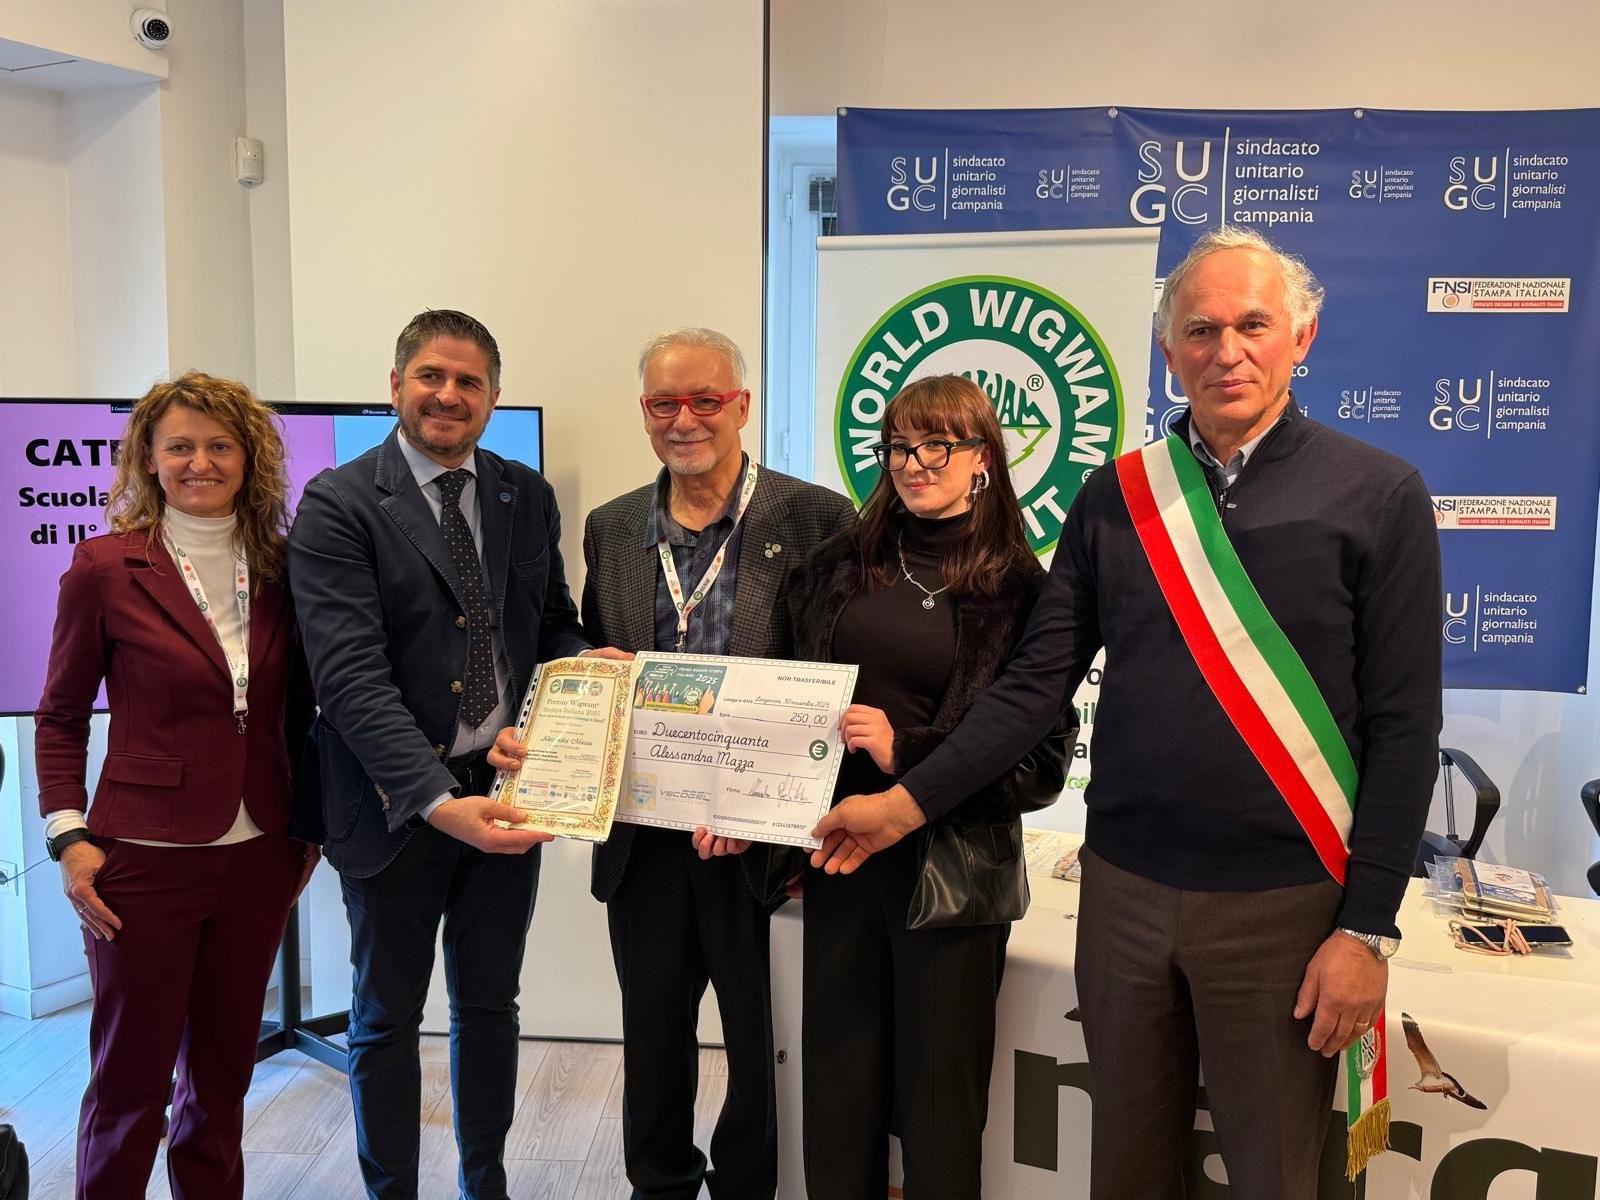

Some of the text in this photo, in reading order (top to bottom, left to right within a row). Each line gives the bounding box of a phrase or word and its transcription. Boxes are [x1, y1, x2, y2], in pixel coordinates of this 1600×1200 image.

[1236, 138, 1320, 155] sindacato
[952, 155, 1005, 167] sindacato
[1514, 155, 1568, 166] sindacato
[952, 170, 996, 181] unitario
[1235, 163, 1304, 178] unitario
[1513, 170, 1558, 180] unitario
[952, 184, 1006, 198] giornalisti
[1233, 184, 1319, 205] giornalisti
[1384, 191, 1411, 199] campania
[1512, 184, 1566, 197] giornalisti
[952, 200, 1002, 213] campania
[1512, 199, 1561, 212] campania
[1233, 208, 1314, 227] campania
[1433, 282, 1471, 294] FNSI
[969, 289, 1112, 466] WIGWAM
[1498, 377, 1550, 387] sindacato
[1498, 392, 1540, 402] unitario
[1496, 406, 1550, 418] giornalisti
[1496, 420, 1546, 432] campania
[19, 486, 110, 506] Scuola
[1432, 500, 1456, 511] NSI
[31, 524, 57, 544] di
[1484, 592, 1537, 602] sindacato
[1484, 606, 1527, 615] unitario
[1482, 619, 1537, 631] giornalisti
[1482, 633, 1533, 645] campania
[696, 675, 718, 685] 2025
[793, 677, 836, 685] TRASFERIBILE
[652, 722, 769, 749] Duecentocinquanta
[650, 744, 712, 763] Alessandra
[717, 751, 754, 772] Mazza
